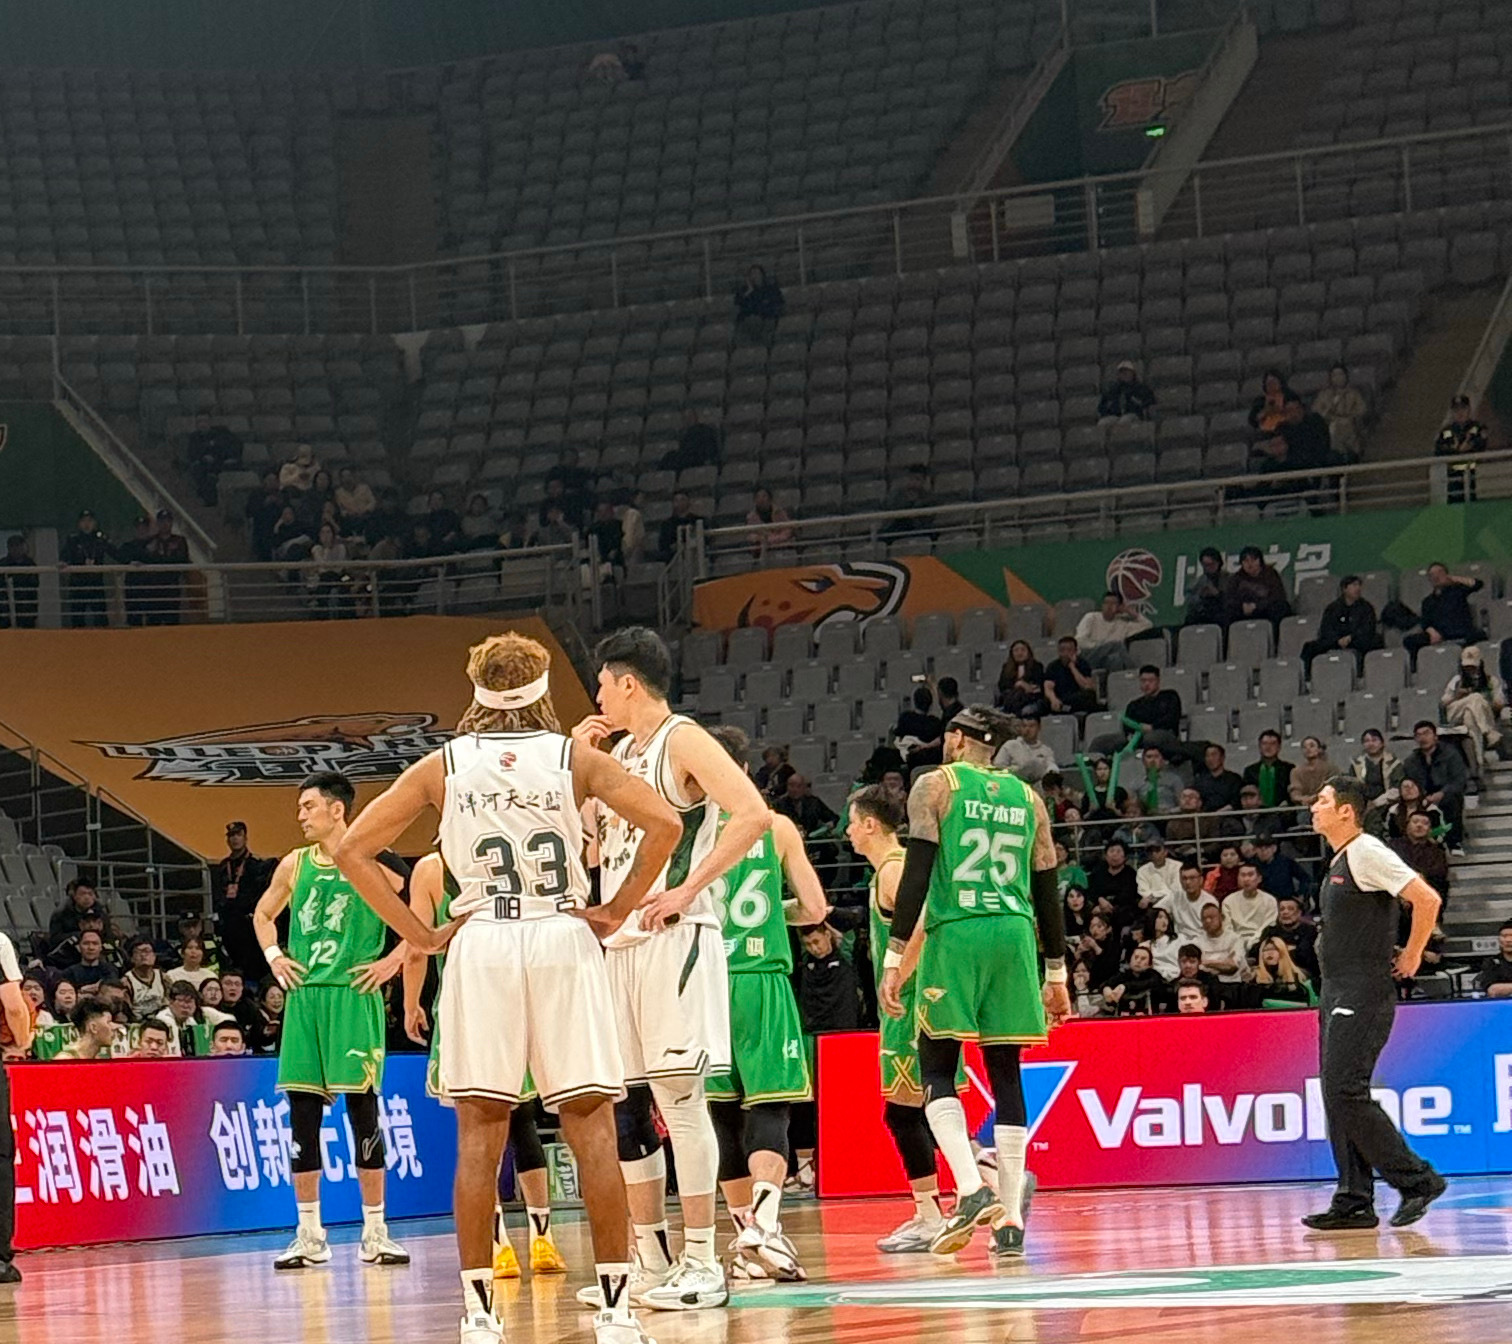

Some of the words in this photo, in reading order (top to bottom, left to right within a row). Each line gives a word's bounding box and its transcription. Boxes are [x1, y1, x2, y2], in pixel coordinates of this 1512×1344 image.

[964, 799, 1027, 827] 辽宁本钢
[472, 827, 572, 897] 33
[952, 827, 1026, 887] 25
[1076, 1076, 1452, 1149] Valvole
[10, 1104, 180, 1204] 润滑油
